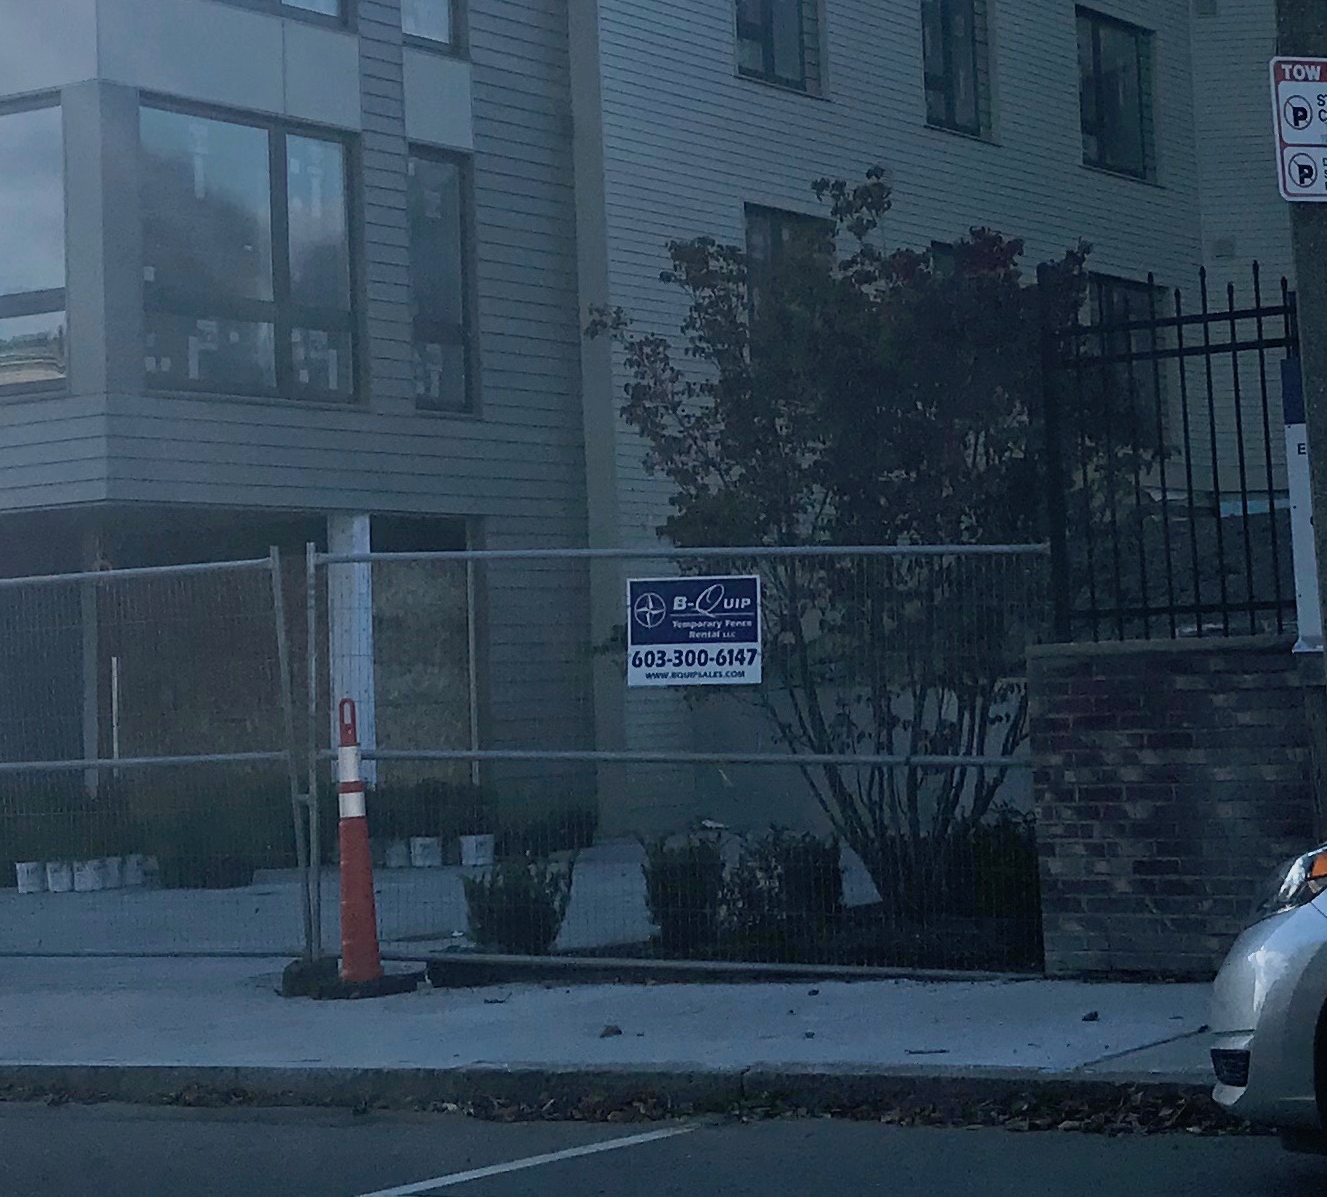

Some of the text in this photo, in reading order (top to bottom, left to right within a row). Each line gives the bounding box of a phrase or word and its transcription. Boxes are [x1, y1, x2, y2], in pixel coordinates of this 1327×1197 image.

[1281, 64, 1321, 81] TOW
[673, 619, 753, 630] Temporary Fence
[689, 631, 720, 639] Rental
[631, 648, 758, 668] 603-300-6147
